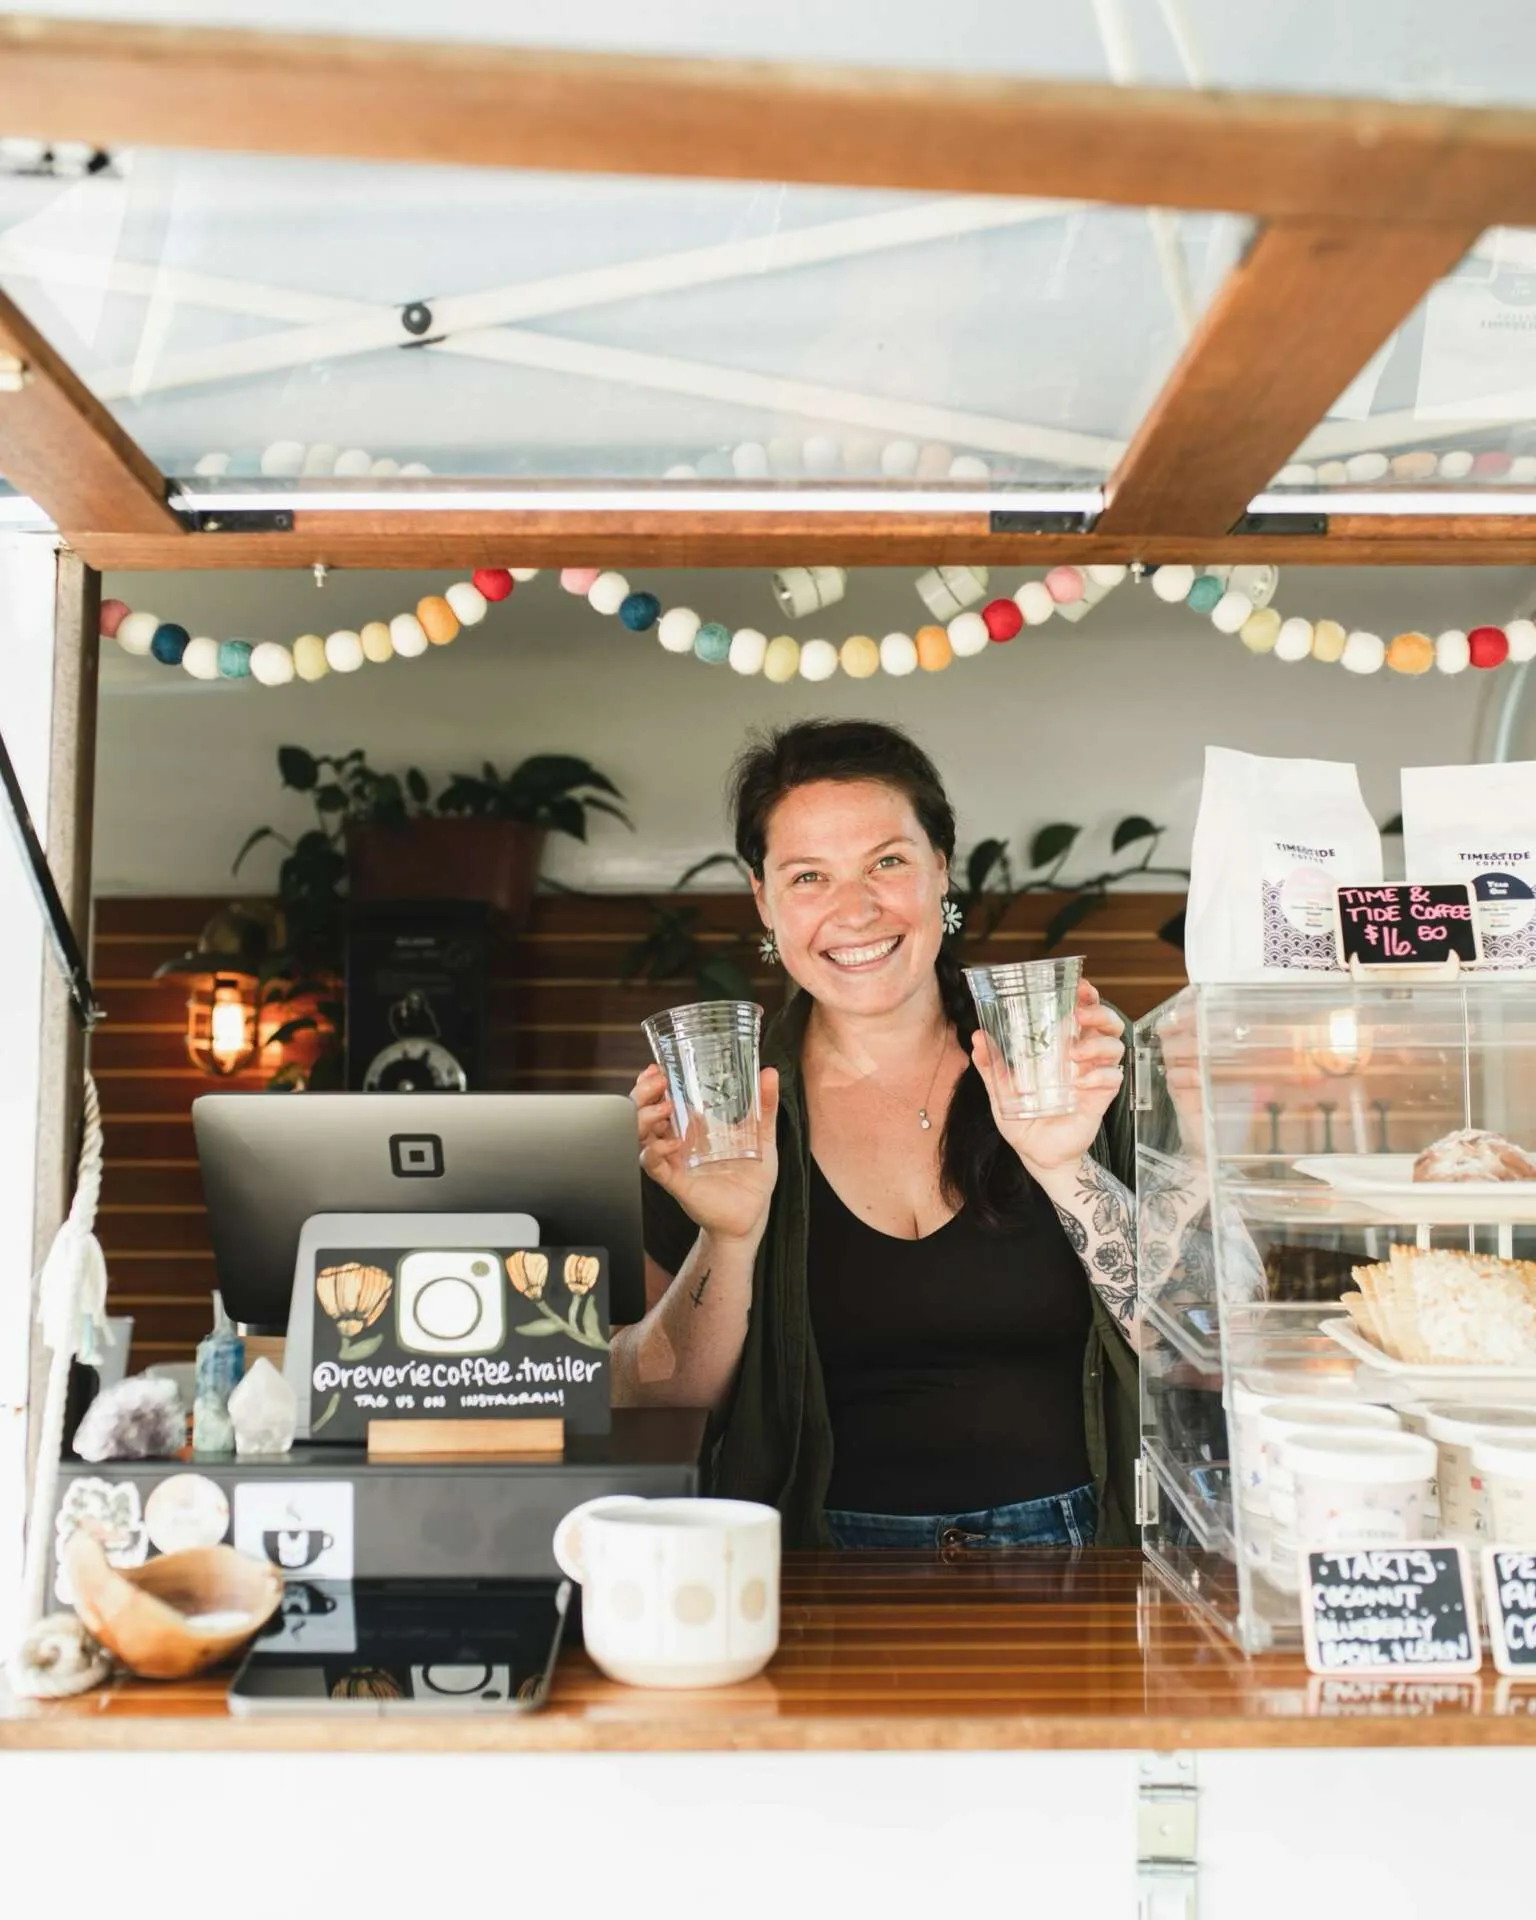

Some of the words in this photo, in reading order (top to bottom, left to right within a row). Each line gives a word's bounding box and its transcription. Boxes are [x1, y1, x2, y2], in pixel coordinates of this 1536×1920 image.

[1339, 888, 1400, 904] TIME
[1409, 886, 1431, 903] &
[1345, 905, 1402, 922] TIDE
[312, 1356, 602, 1391] @reveriecoffee.trailer
[353, 1394, 389, 1408] TAG
[395, 1394, 416, 1409] US
[423, 1395, 445, 1408] ON
[460, 1389, 565, 1407] INSTAGRAM!
